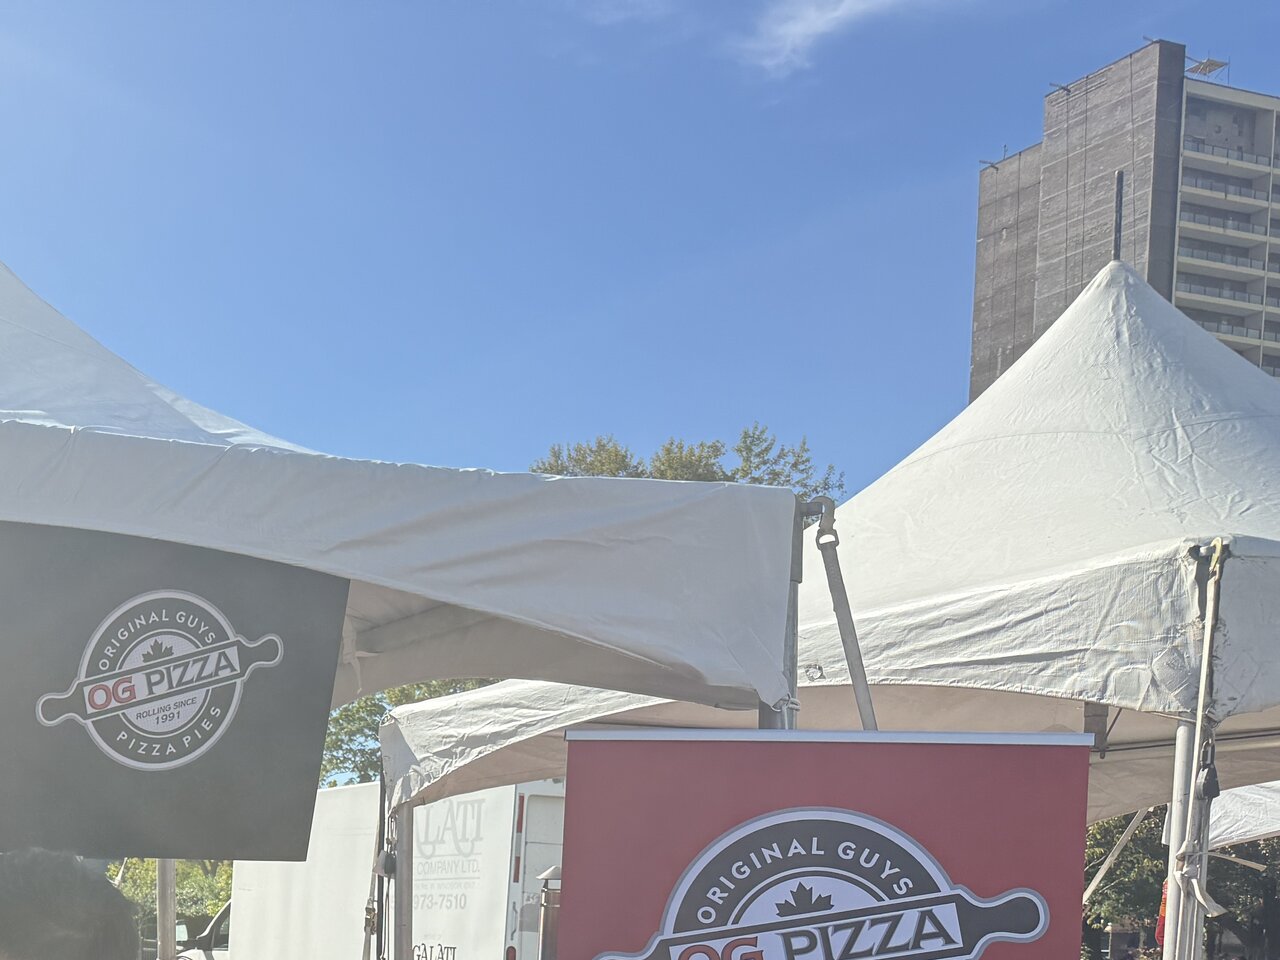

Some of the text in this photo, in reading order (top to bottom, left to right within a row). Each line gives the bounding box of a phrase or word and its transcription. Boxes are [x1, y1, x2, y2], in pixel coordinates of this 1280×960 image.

[98, 608, 216, 671] ORIGINAL GUYS
[87, 649, 238, 711] OG PIZZA
[117, 705, 221, 756] PIZZA PIES
[136, 696, 198, 721] ROLLING SINCE
[155, 710, 181, 726] 1991
[696, 837, 914, 925] ORIGINAL GUYS
